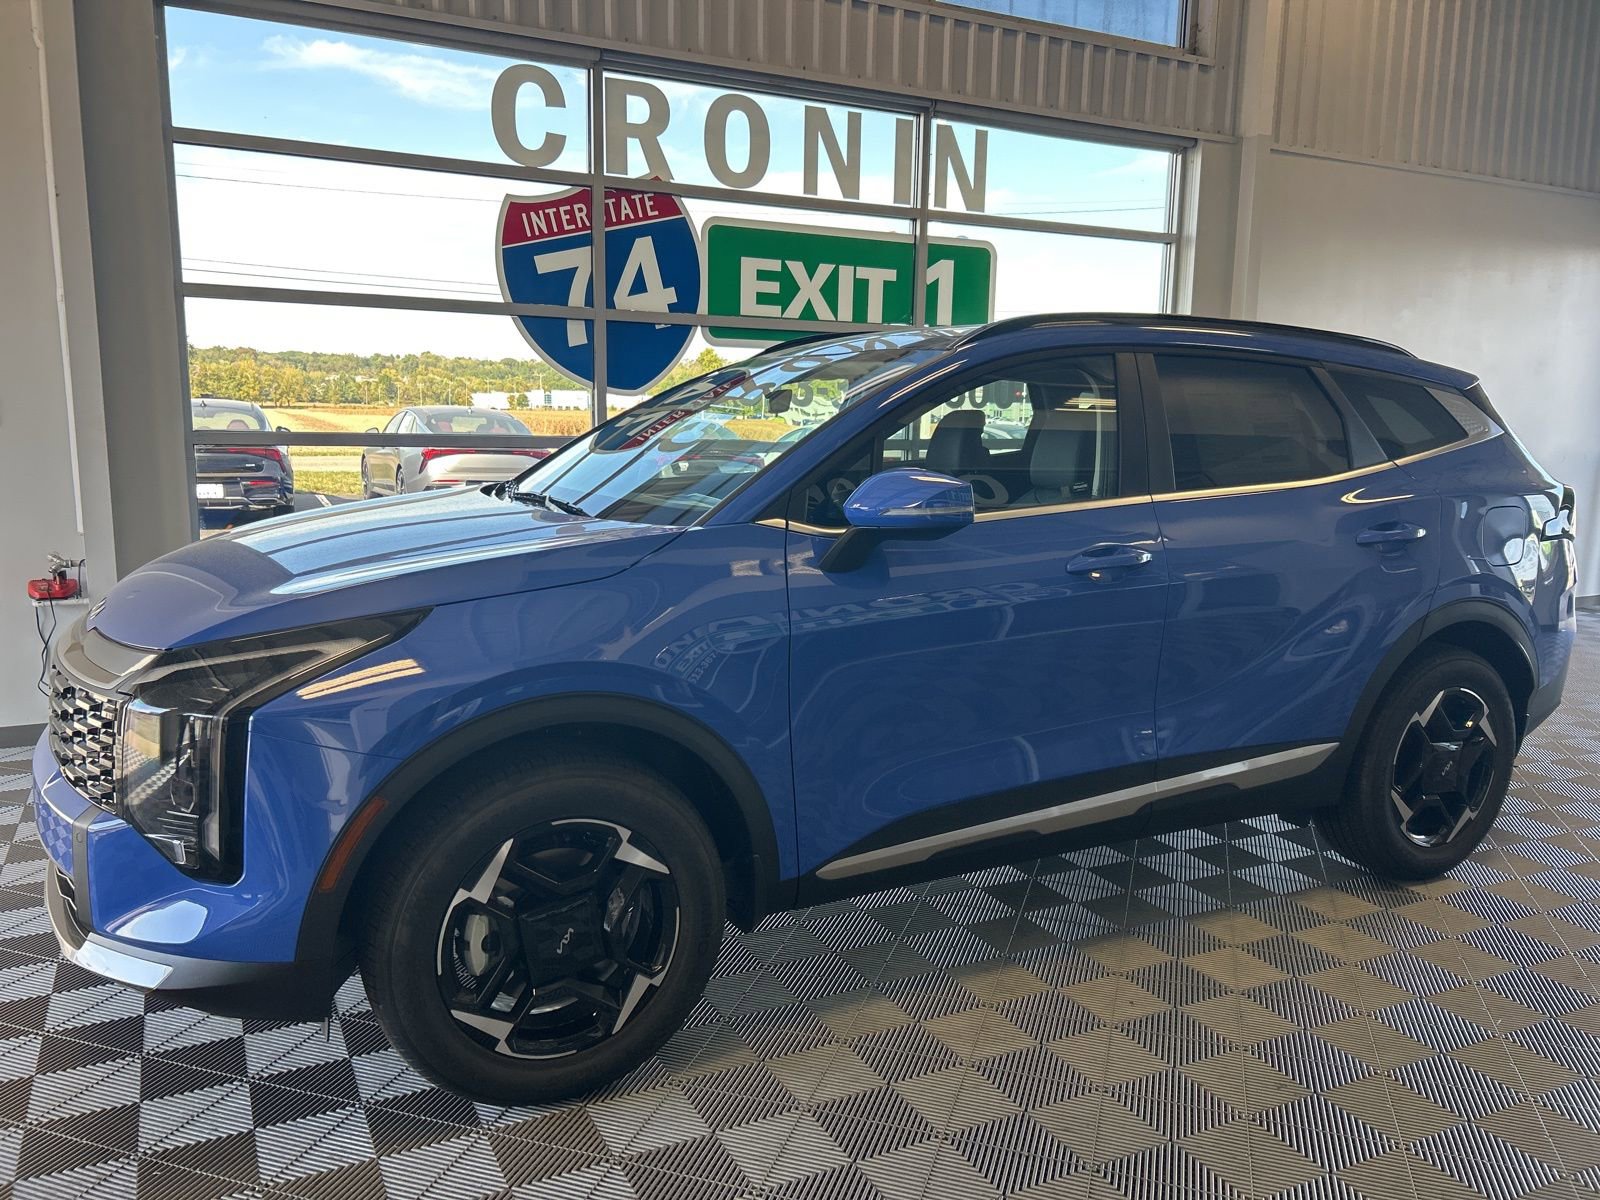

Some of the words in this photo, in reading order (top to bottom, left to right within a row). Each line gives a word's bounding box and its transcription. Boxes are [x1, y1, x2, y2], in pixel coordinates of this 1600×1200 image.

[490, 63, 989, 213] CRONIN
[521, 192, 659, 238] INTERTATE
[533, 235, 678, 348] 74
[739, 256, 898, 324] EXIT
[925, 259, 955, 326] 1
